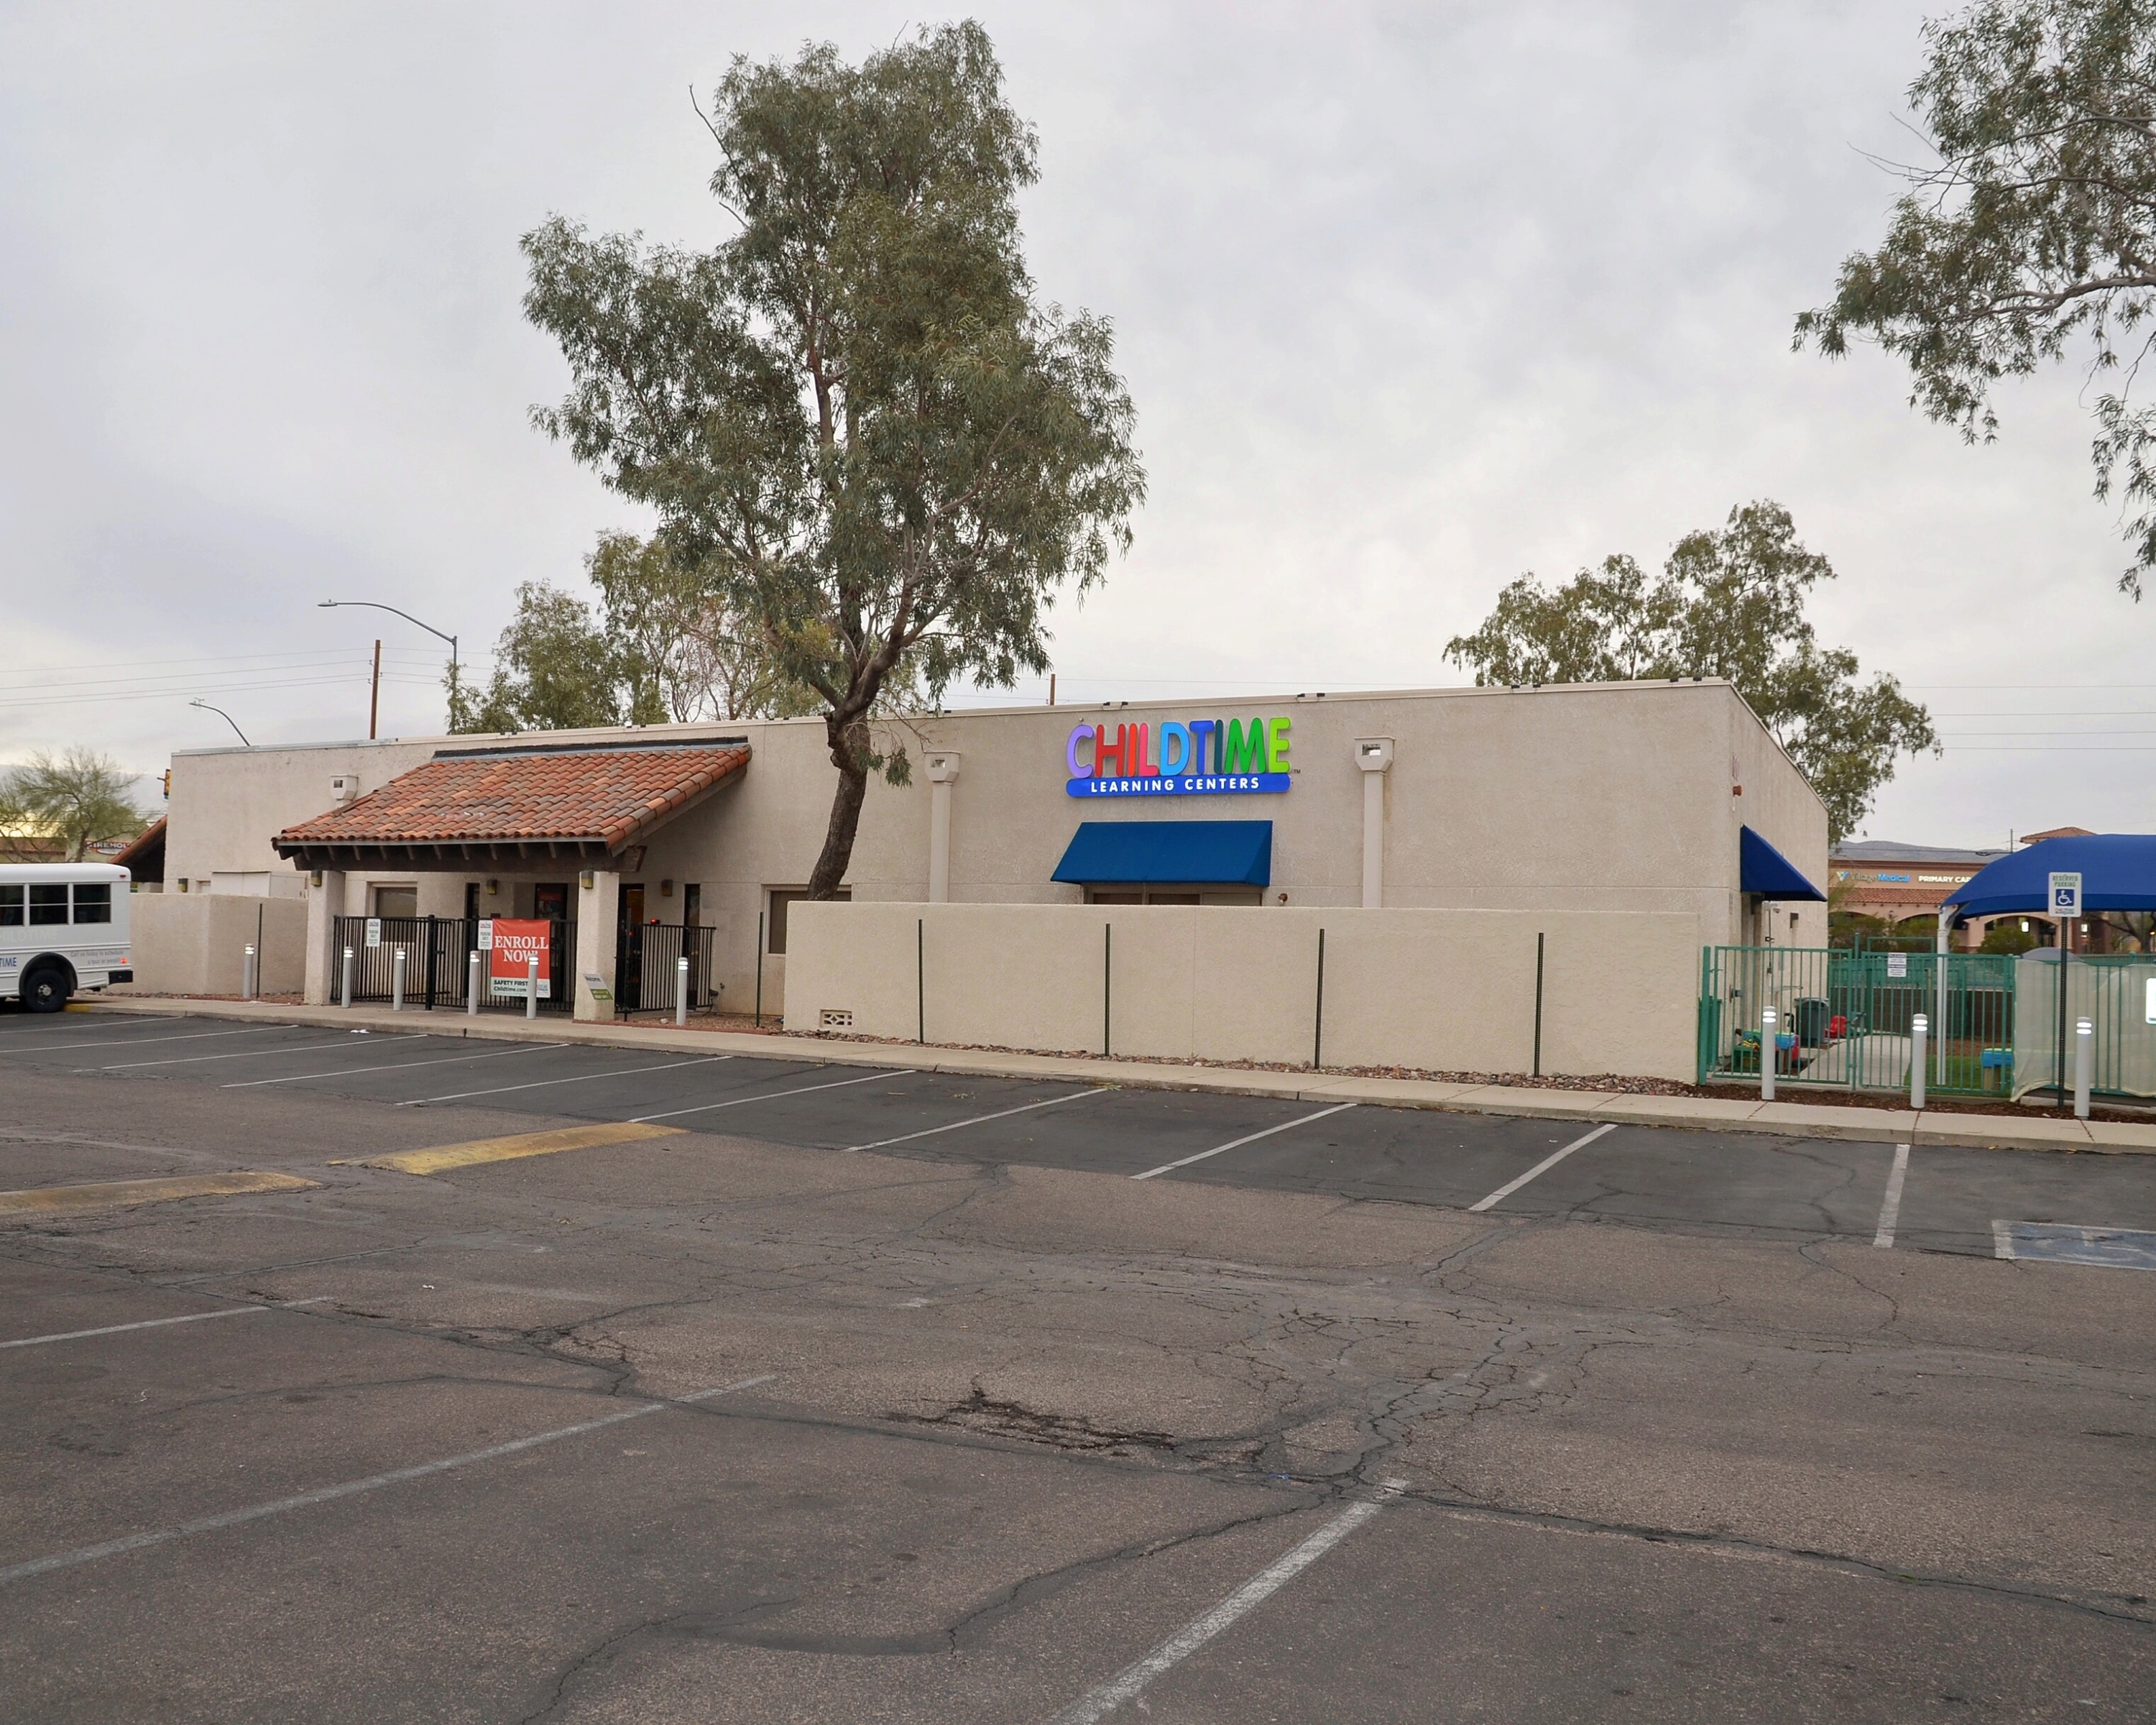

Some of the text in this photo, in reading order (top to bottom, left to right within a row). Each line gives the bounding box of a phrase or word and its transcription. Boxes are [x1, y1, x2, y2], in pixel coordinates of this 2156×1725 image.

[1067, 717, 1291, 778] CHILDTIME
[1091, 777, 1259, 793] LEARNING CENTERS
[494, 936, 549, 949] ENROLL
